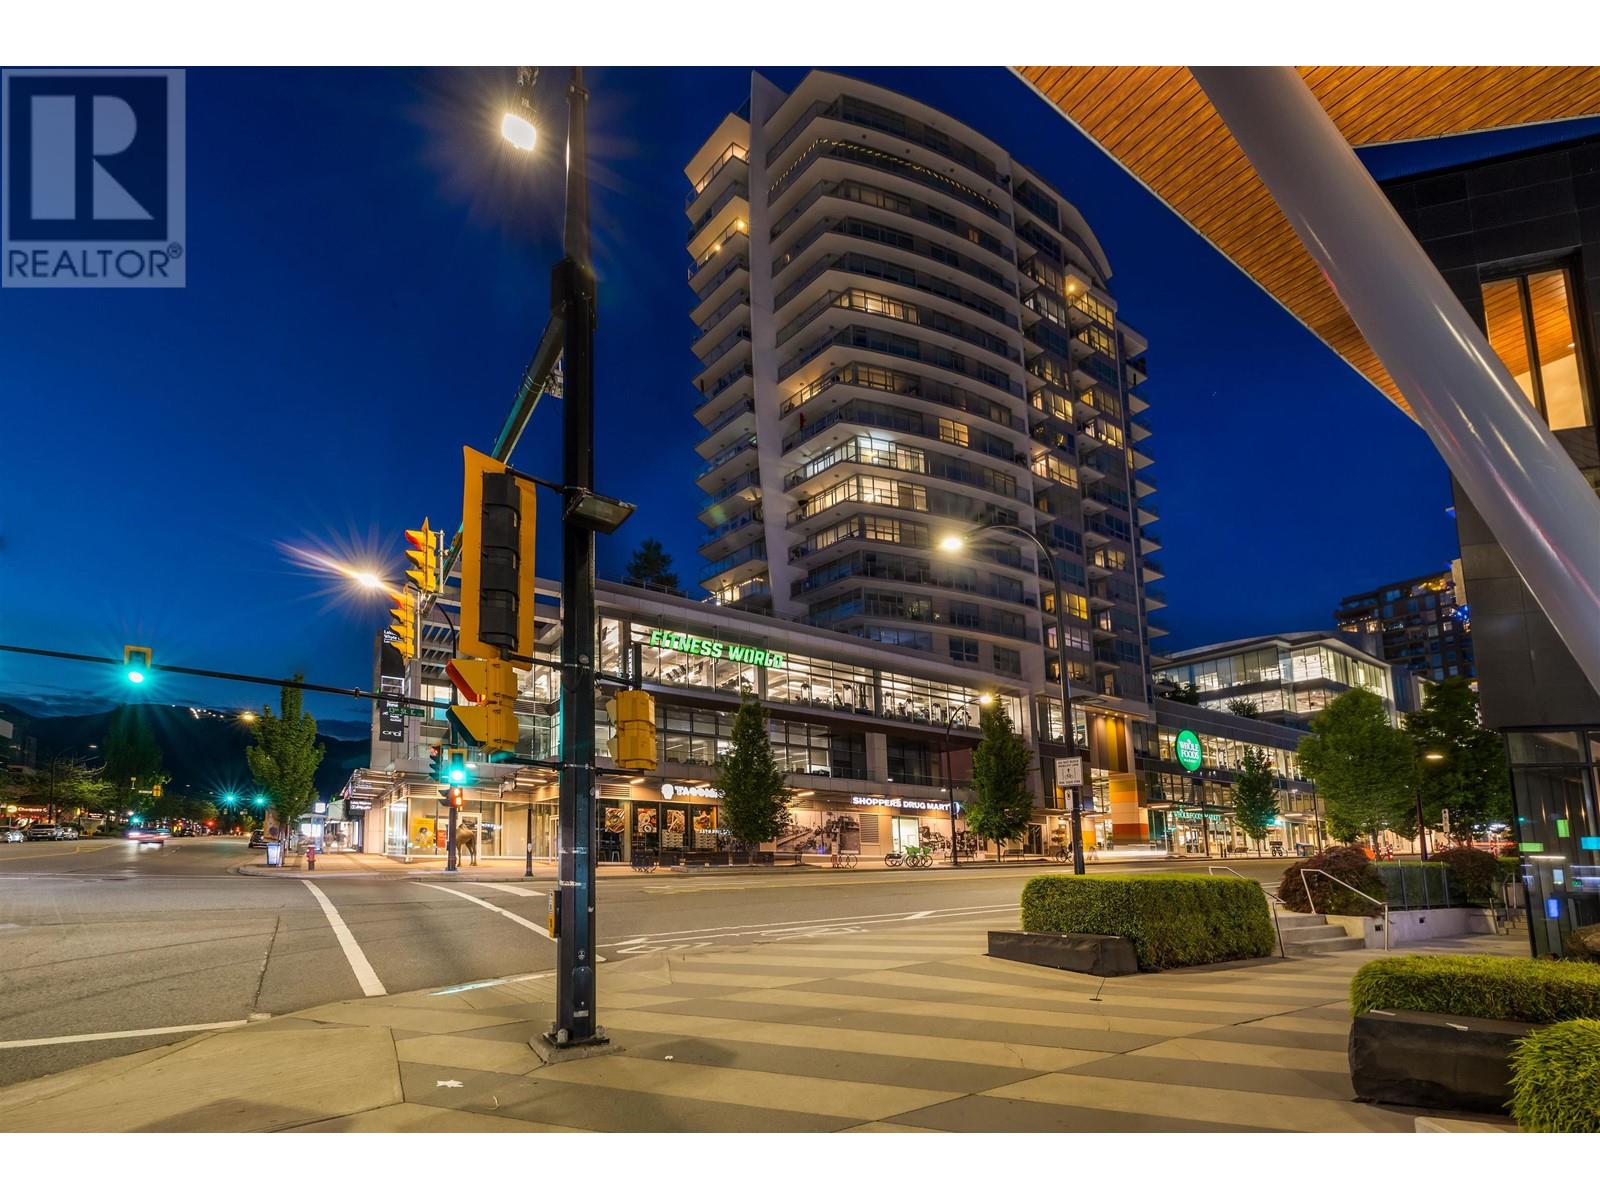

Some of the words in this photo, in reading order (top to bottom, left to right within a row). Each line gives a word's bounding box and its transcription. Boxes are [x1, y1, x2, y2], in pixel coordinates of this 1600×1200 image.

[649, 630, 723, 658] FITNESS
[728, 644, 784, 668] WORLD
[1179, 739, 1199, 750] WHOLE
[1181, 749, 1200, 760] FOODS
[852, 796, 901, 808] SHOPPERS
[903, 800, 926, 810] DRUG
[926, 803, 951, 812] MART
